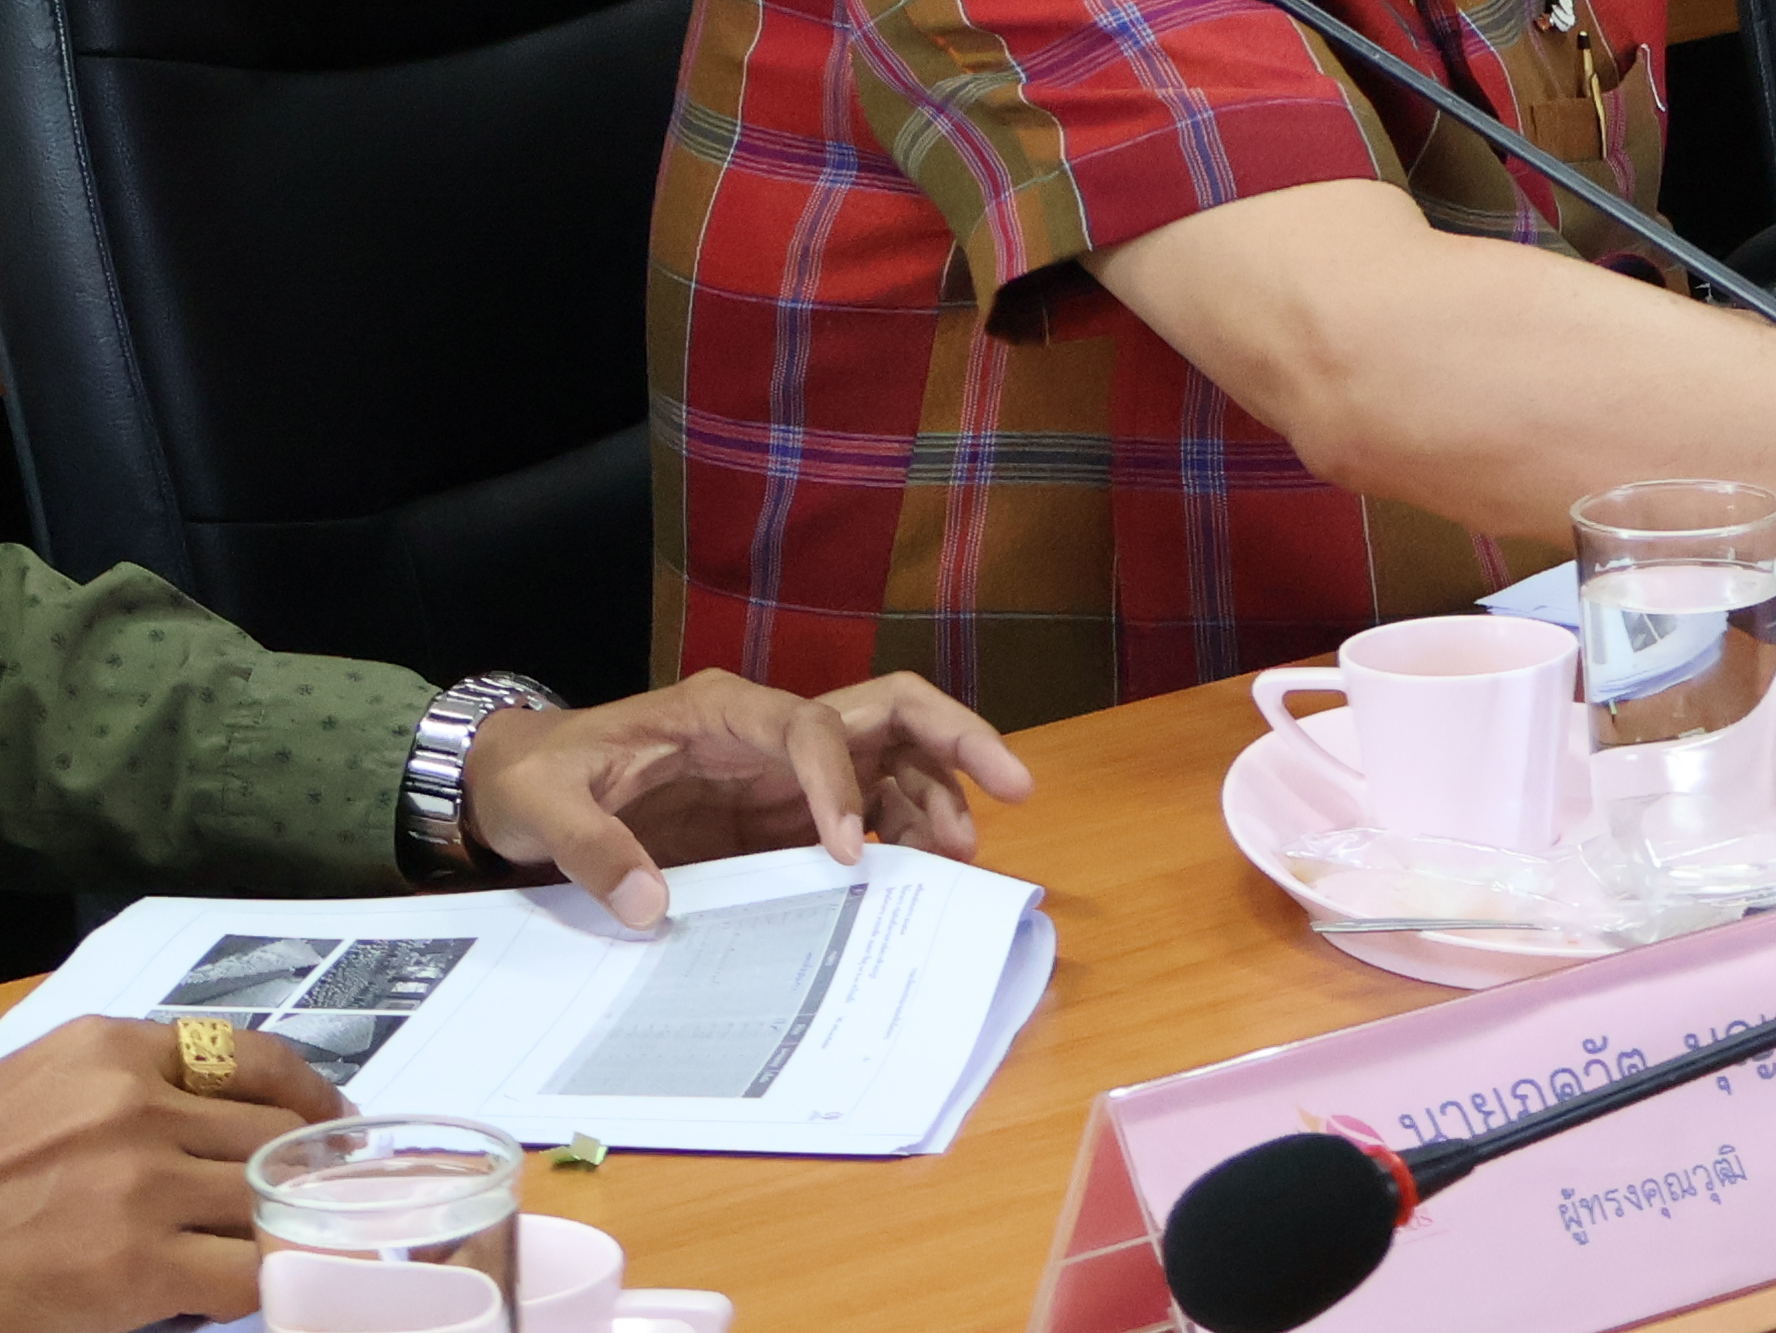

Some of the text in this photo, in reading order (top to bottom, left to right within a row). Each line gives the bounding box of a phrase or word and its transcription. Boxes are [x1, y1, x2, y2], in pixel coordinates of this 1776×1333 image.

[1557, 1144, 1748, 1245] ผู้ทรงคุณวุฒิ
